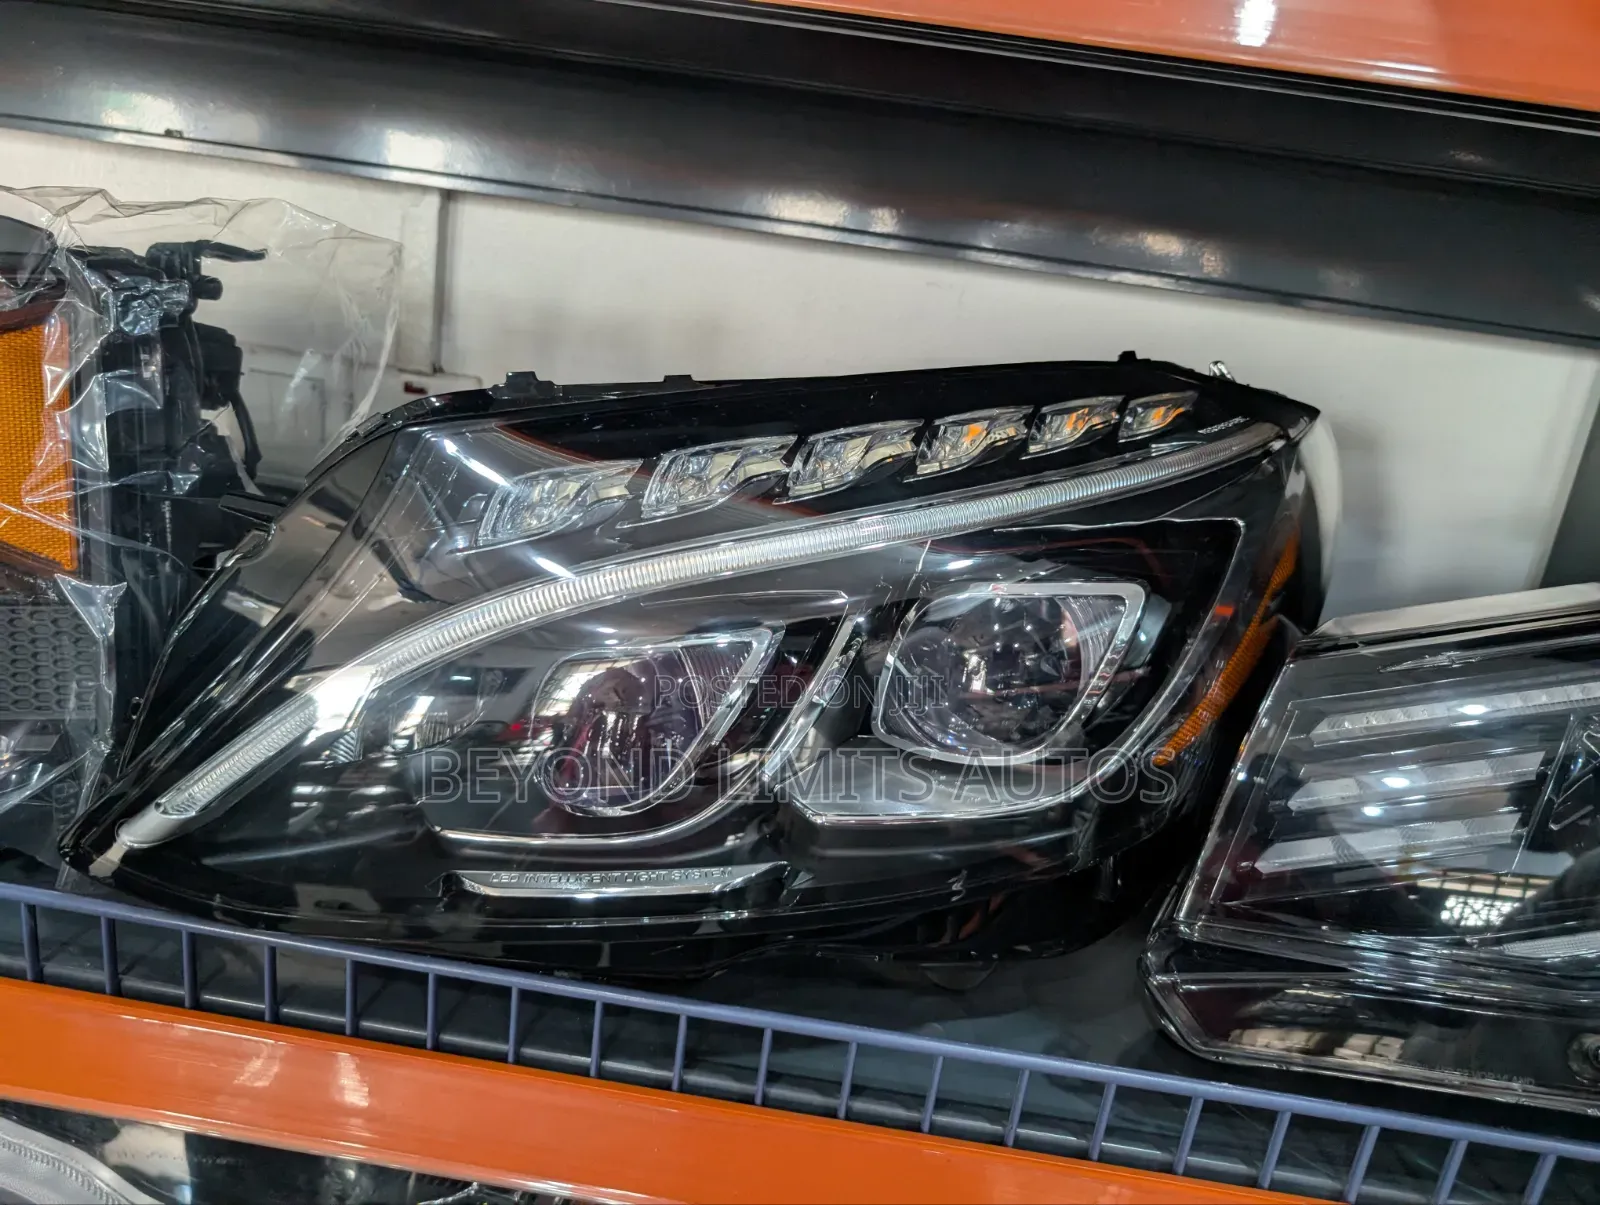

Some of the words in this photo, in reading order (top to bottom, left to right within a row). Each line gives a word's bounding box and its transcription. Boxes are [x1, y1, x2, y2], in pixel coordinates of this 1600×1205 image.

[489, 872, 519, 883] LED
[523, 872, 621, 884] INTELLIGENT
[624, 870, 668, 883] LIGHT
[671, 867, 732, 880] SYSTEM
